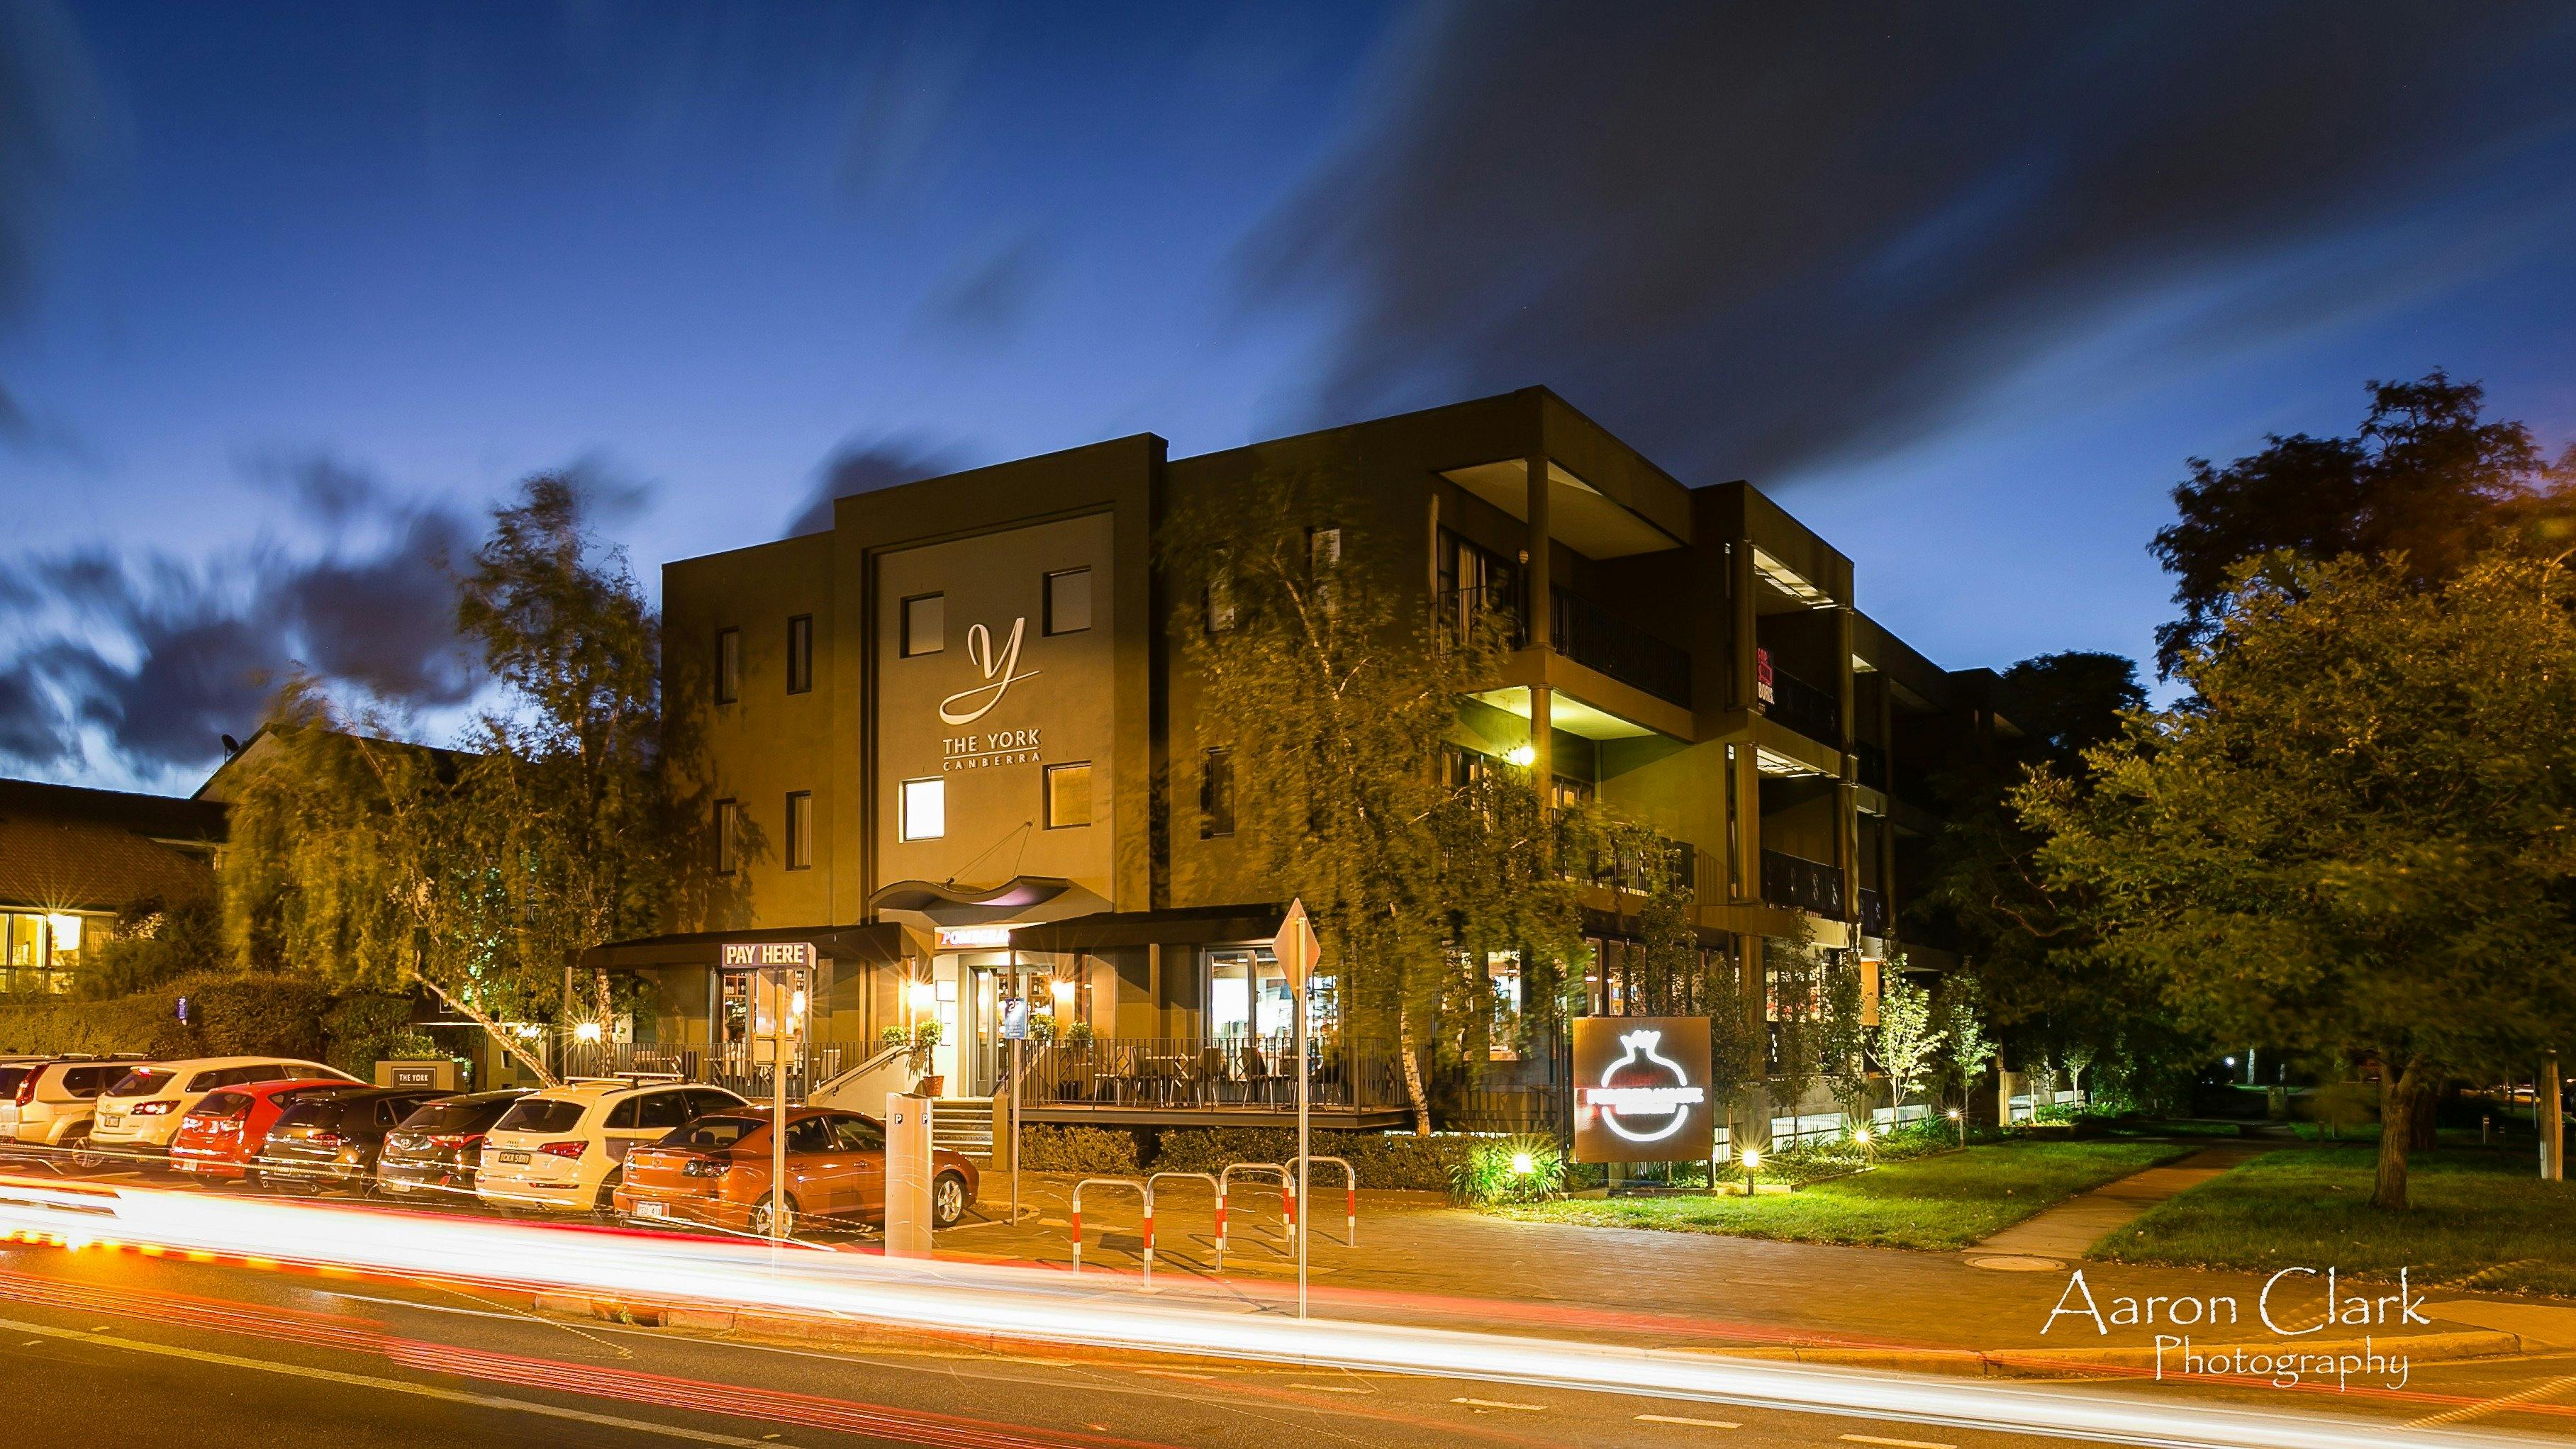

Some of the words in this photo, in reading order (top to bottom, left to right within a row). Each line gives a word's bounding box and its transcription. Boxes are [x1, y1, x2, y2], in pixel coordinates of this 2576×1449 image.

[942, 735, 978, 754] THE
[987, 729, 1041, 749] YORK
[942, 751, 1041, 771] CANBERRA
[726, 945, 757, 965] PAY
[762, 944, 804, 963] HERE
[398, 1073, 411, 1082] THE
[412, 1073, 428, 1082] YORK
